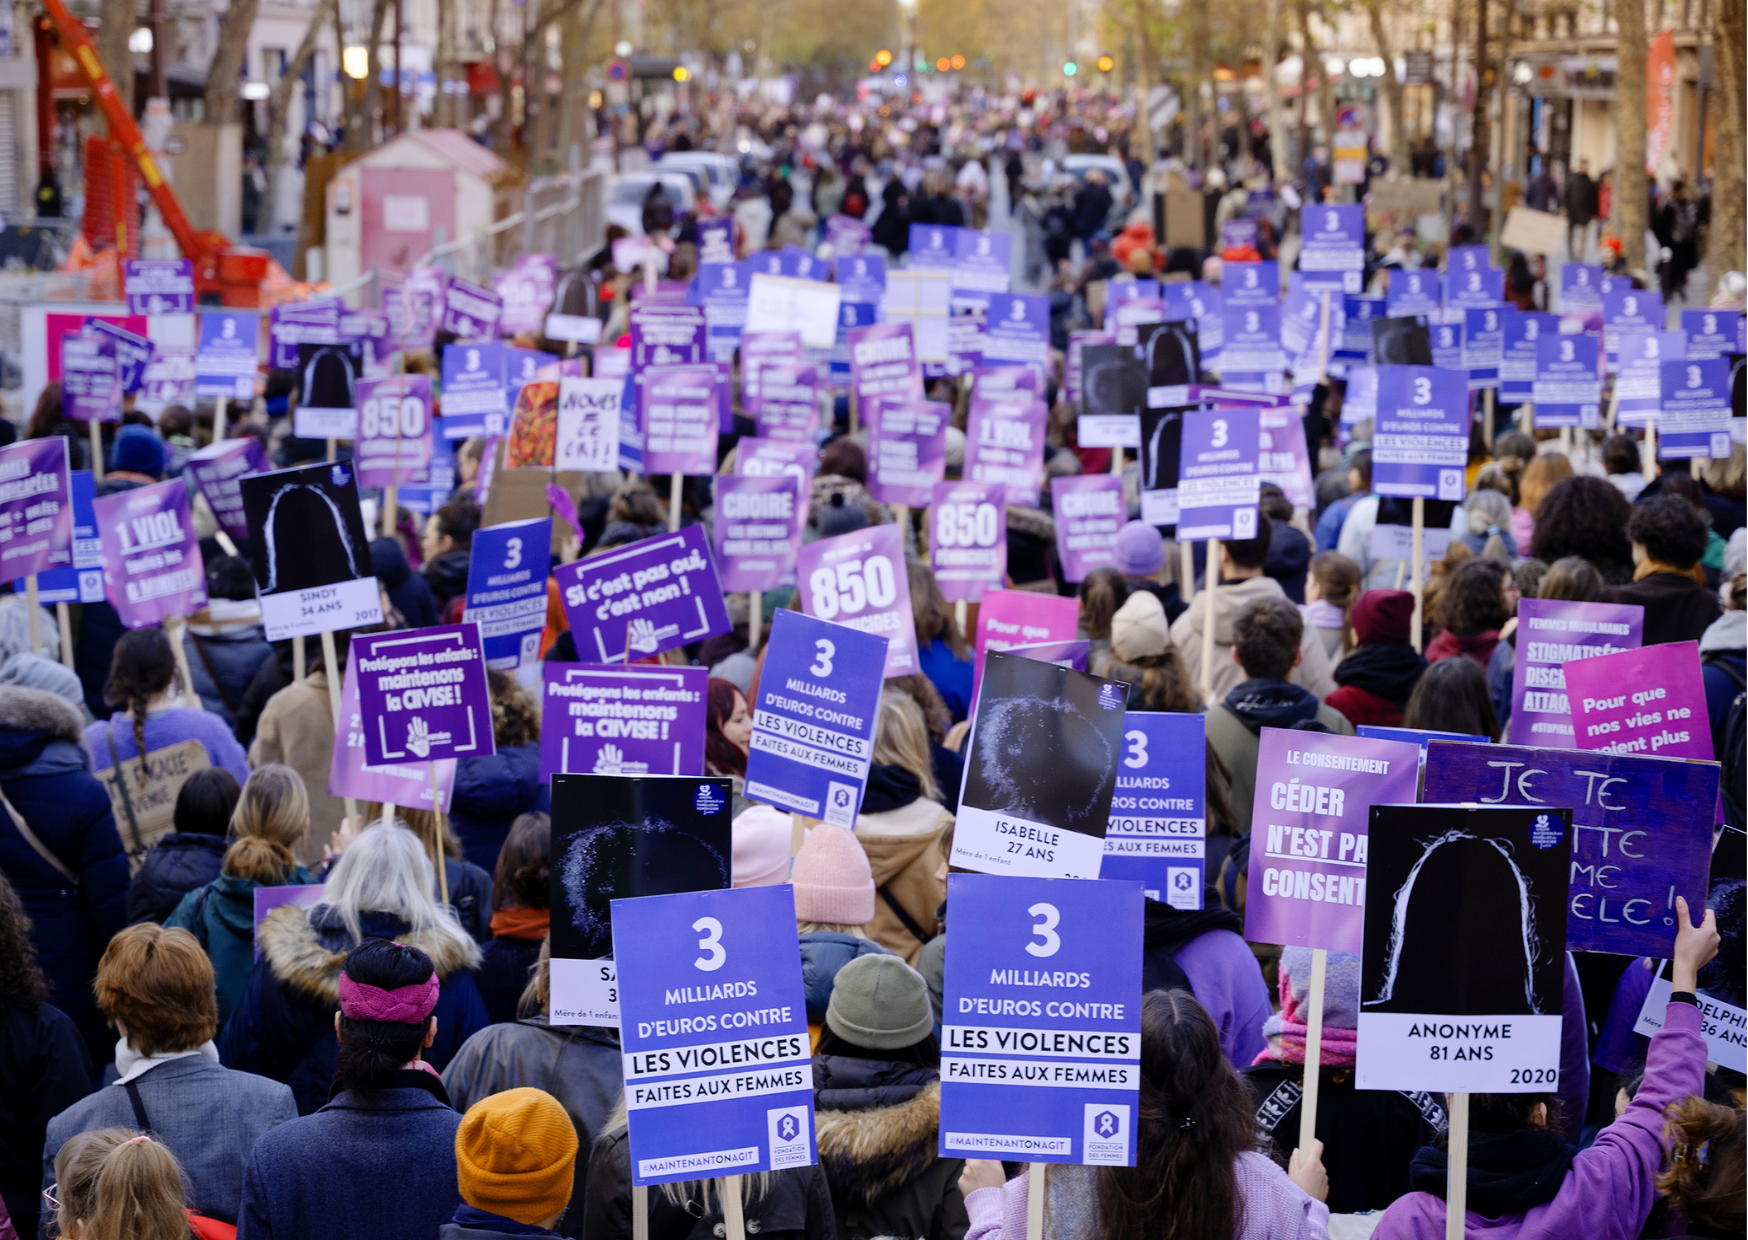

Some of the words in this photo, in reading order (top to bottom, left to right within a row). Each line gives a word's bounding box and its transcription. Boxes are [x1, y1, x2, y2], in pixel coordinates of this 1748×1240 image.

[1325, 211, 1339, 232] 3
[977, 235, 992, 257] 3
[722, 266, 737, 290] 3
[1244, 268, 1258, 289] 3
[1468, 271, 1482, 292] 3
[1011, 299, 1026, 321] 3
[1623, 296, 1638, 316] 3
[1245, 311, 1260, 333] 3
[1484, 310, 1498, 332] 3
[1525, 318, 1539, 341] 3
[1702, 314, 1717, 335] 3
[1439, 326, 1454, 348] 3
[1644, 336, 1659, 359] 3
[1560, 340, 1575, 362] 3
[1686, 365, 1703, 389] 3
[1413, 377, 1432, 405] 3
[361, 396, 425, 439] 850
[1211, 419, 1228, 448] 3
[1400, 438, 1462, 448] VIOLENCES
[1200, 478, 1255, 488] VIOLENCES
[722, 491, 793, 519] CROIRE
[115, 521, 132, 548] 1
[131, 509, 184, 546] VIOL
[936, 503, 998, 547] 850
[504, 537, 523, 569] 3
[487, 569, 531, 587] MILLIARDS
[565, 584, 587, 607] Si
[587, 572, 633, 600] c'est
[633, 563, 670, 591] pas
[670, 548, 707, 575] oui,
[809, 555, 897, 620] 850
[300, 587, 337, 603] SINDY
[472, 590, 510, 605] D'EUROS
[511, 581, 543, 599] CONTRE
[596, 592, 642, 621] c'est
[641, 583, 681, 607] non
[301, 605, 314, 617] 34
[318, 601, 343, 613] ANS
[354, 608, 379, 621] 2017
[467, 608, 485, 621] LES
[488, 600, 543, 617] VIOLENCES
[986, 618, 1021, 635] Pour
[1022, 625, 1050, 639] que
[1529, 617, 1567, 631] FEMMES
[1569, 620, 1630, 636] MUSULMANES
[360, 655, 418, 673] Protégeons
[418, 652, 434, 666] les
[434, 647, 473, 663] enfants
[809, 638, 836, 678] 3
[1527, 641, 1630, 661] STIGMATISÉ
[378, 667, 465, 691] maintenons
[386, 693, 403, 712] la
[402, 685, 454, 710] CIIVISE
[549, 682, 622, 701] Protégeons
[622, 685, 641, 700] les
[642, 686, 693, 702] enfants
[786, 678, 847, 704] MILLIARDS
[1524, 691, 1571, 712] ATTAQ
[1583, 694, 1627, 714] Pour
[1631, 687, 1666, 706] que
[568, 698, 678, 721] maintenons
[765, 693, 814, 717] D'EUROS
[815, 707, 864, 730] CONTRE
[575, 718, 594, 737] la
[595, 718, 659, 740] CIIVISE
[1531, 722, 1575, 736] #STOPISLA
[1587, 720, 1621, 737] nos
[1625, 712, 1662, 729] vies
[1667, 707, 1691, 721] ne
[758, 714, 781, 731] LES
[785, 721, 862, 754] VIOLENCES
[1651, 729, 1690, 751] plus
[756, 736, 788, 754] FAITES
[790, 748, 812, 760] AUX
[814, 753, 859, 774] FEMMES
[1123, 730, 1149, 769] 3
[1287, 750, 1300, 765] LE
[1303, 752, 1390, 775] CONSENTEMENT
[1115, 776, 1170, 790] LLIARDS
[1480, 760, 1548, 803] JE
[1573, 770, 1628, 811] TE
[1138, 798, 1194, 811] CONTRE
[1270, 777, 1345, 817] CÉDER
[995, 820, 1060, 847] ISABELLE
[1107, 819, 1198, 834] VIOLENCES
[1007, 841, 1023, 854] 27
[1025, 845, 1055, 863] ANS
[1117, 843, 1142, 853] AUX
[1146, 843, 1197, 854] FEMMES
[1265, 824, 1334, 859] N'EST
[955, 847, 973, 858] Mère
[974, 851, 983, 859] de
[990, 855, 1012, 866] enfant
[1570, 861, 1622, 888] ME
[1025, 902, 1061, 958] 3
[691, 916, 727, 972] 3
[990, 969, 1091, 989] MILLIARDS
[664, 980, 758, 1006] MILLIARDS
[554, 1009, 576, 1018] Mère
[577, 1009, 587, 1018] de
[959, 997, 1042, 1017] D'EUROS
[1045, 1001, 1125, 1020] CONTRE
[1696, 1000, 1748, 1030] DELPHI
[637, 1015, 717, 1039] D'EUROS
[720, 1006, 792, 1030] CONTRE
[1408, 1023, 1512, 1040] ANONYME
[1643, 1016, 1662, 1029] Mère
[950, 1029, 989, 1048] LES
[995, 1031, 1130, 1055] VIOLENCES
[1700, 1021, 1718, 1036] 36
[1718, 1030, 1748, 1048] ANS
[633, 1052, 670, 1075] LES
[676, 1037, 801, 1069] VIOLENCES
[1430, 1046, 1448, 1061] 81
[1453, 1046, 1494, 1061] ANS
[949, 1062, 1007, 1079] FAITES
[1011, 1066, 1049, 1081] AUX
[1054, 1067, 1128, 1084] FEMMES
[1510, 1069, 1557, 1084] 2020
[636, 1084, 692, 1104] FAITES
[696, 1079, 731, 1097] AUX
[736, 1071, 803, 1092] FEMMES
[774, 1146, 806, 1155] FONDATION
[949, 1136, 1066, 1150] #MAINTENANTONAGIT
[643, 1151, 754, 1172] #MAINTENANTONAGIT
[785, 1154, 806, 1162] FEMMES
